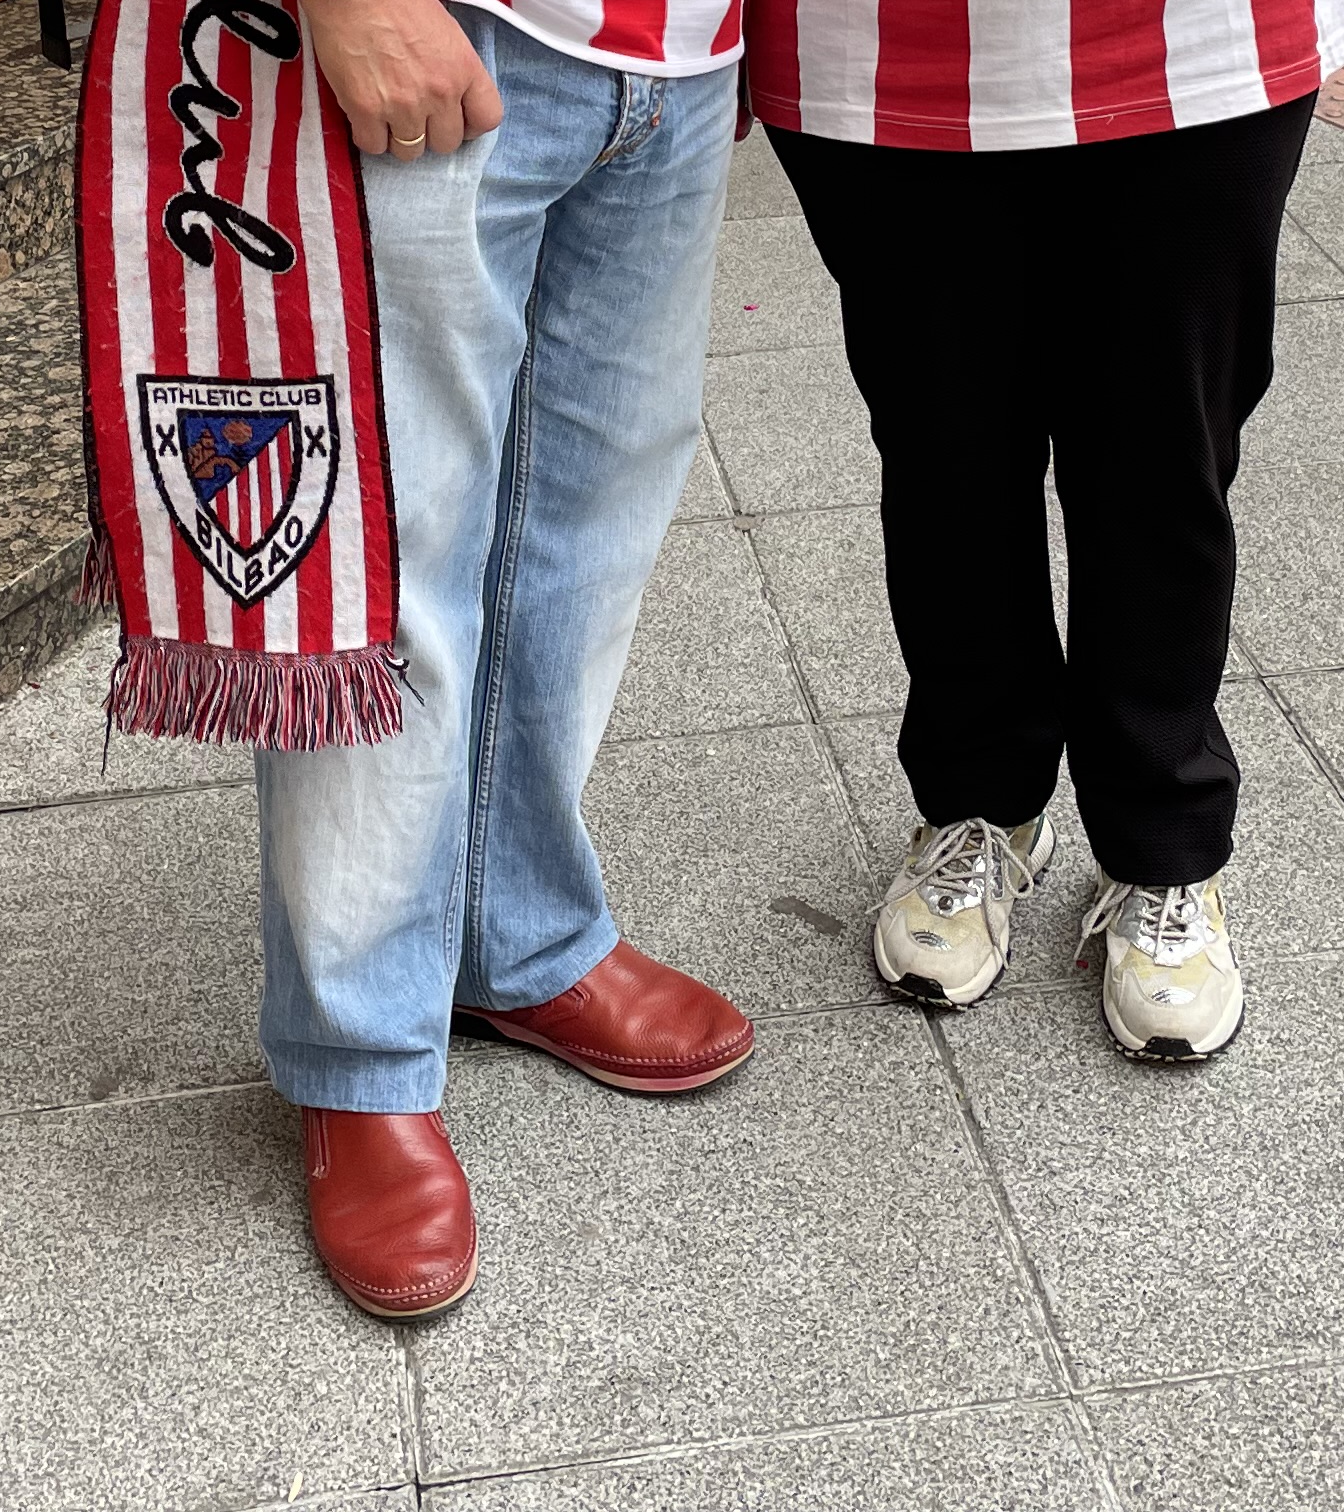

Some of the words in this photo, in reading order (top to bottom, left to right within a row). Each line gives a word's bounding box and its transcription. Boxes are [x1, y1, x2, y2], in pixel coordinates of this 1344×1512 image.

[153, 387, 253, 407] ATHLETIC
[259, 387, 322, 407] CLUB
[194, 508, 304, 596] BILBAO
